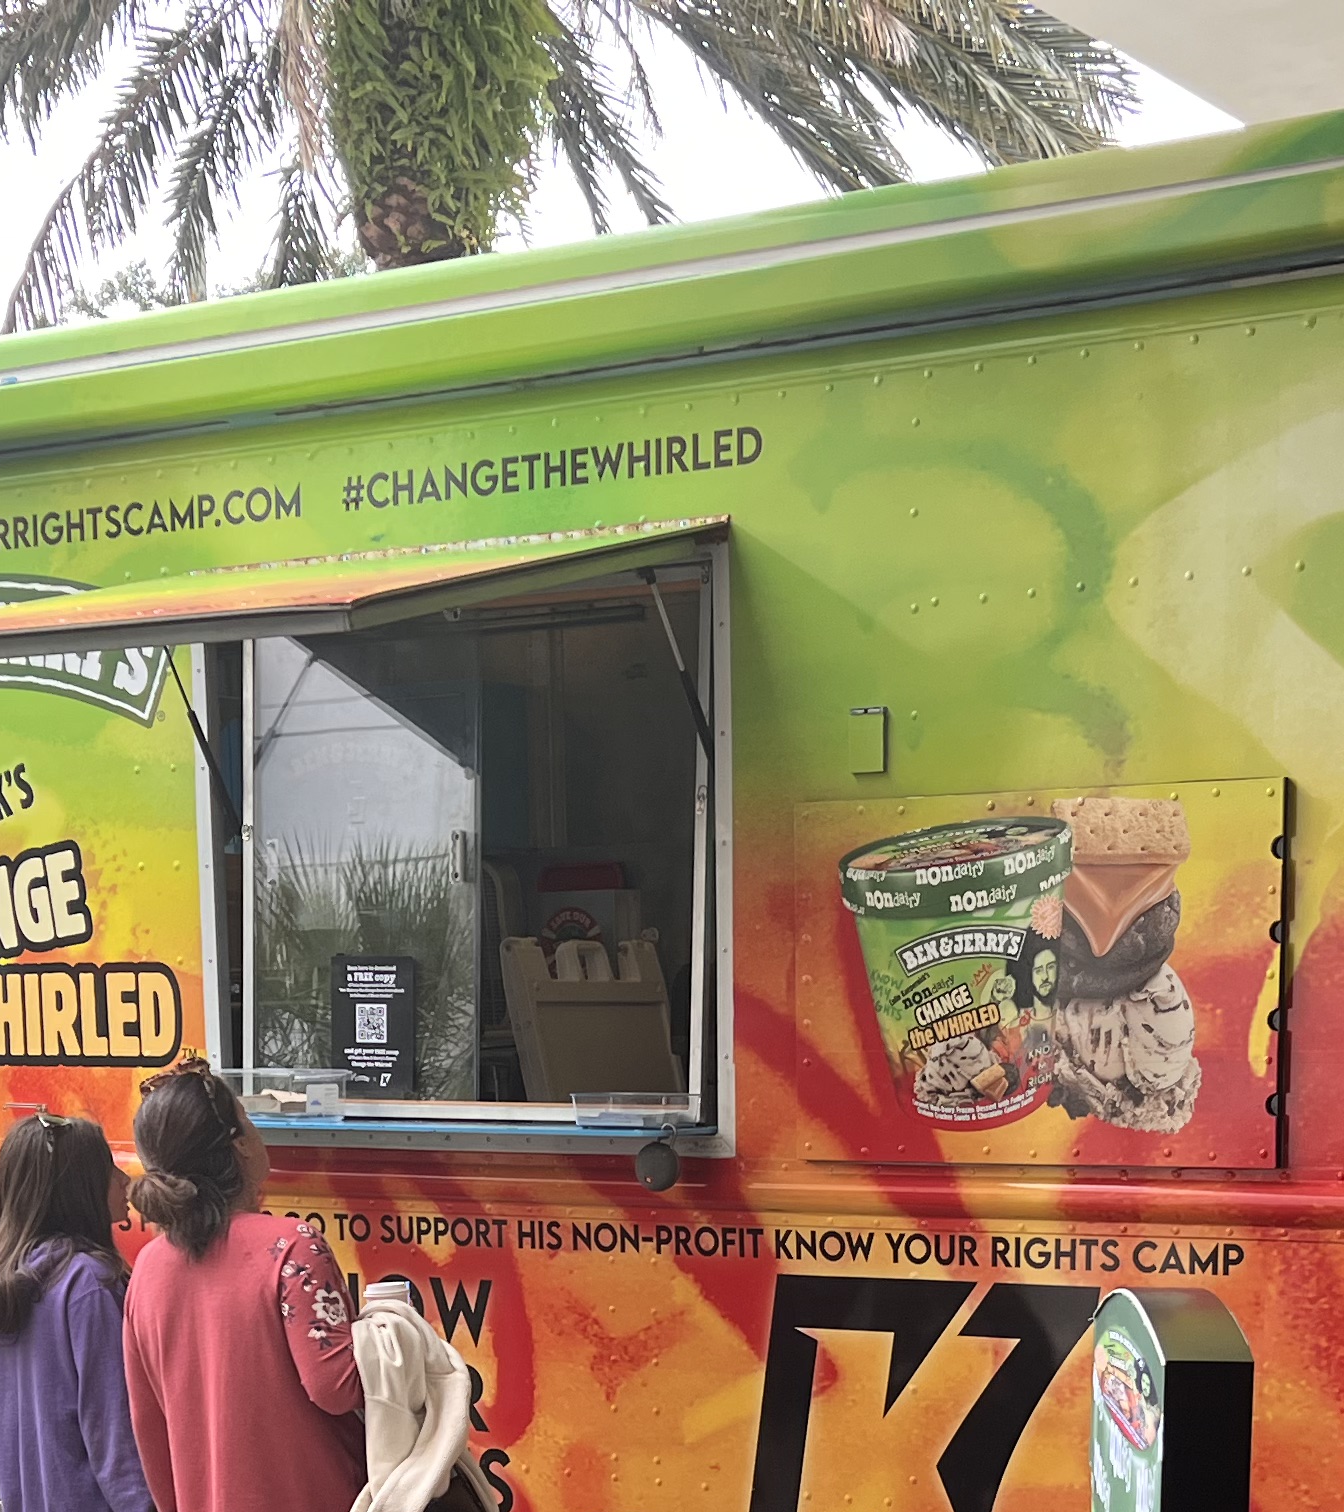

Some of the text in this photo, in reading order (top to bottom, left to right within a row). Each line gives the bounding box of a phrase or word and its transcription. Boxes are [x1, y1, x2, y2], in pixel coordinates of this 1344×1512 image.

[342, 426, 764, 512] #CHANGETHEWHIRLED
[909, 1003, 1000, 1050] the WHIRLED
[915, 984, 973, 1026] CHANGE
[334, 1212, 371, 1242] TO
[380, 1213, 508, 1248] SUPPORT
[517, 1220, 563, 1251] HIS
[572, 1222, 764, 1259] NON-PROFIT
[774, 1228, 875, 1263] KNOW
[885, 1233, 980, 1267] YOUR
[991, 1235, 1121, 1273] RIGHTS
[1131, 1240, 1245, 1277] CAMP
